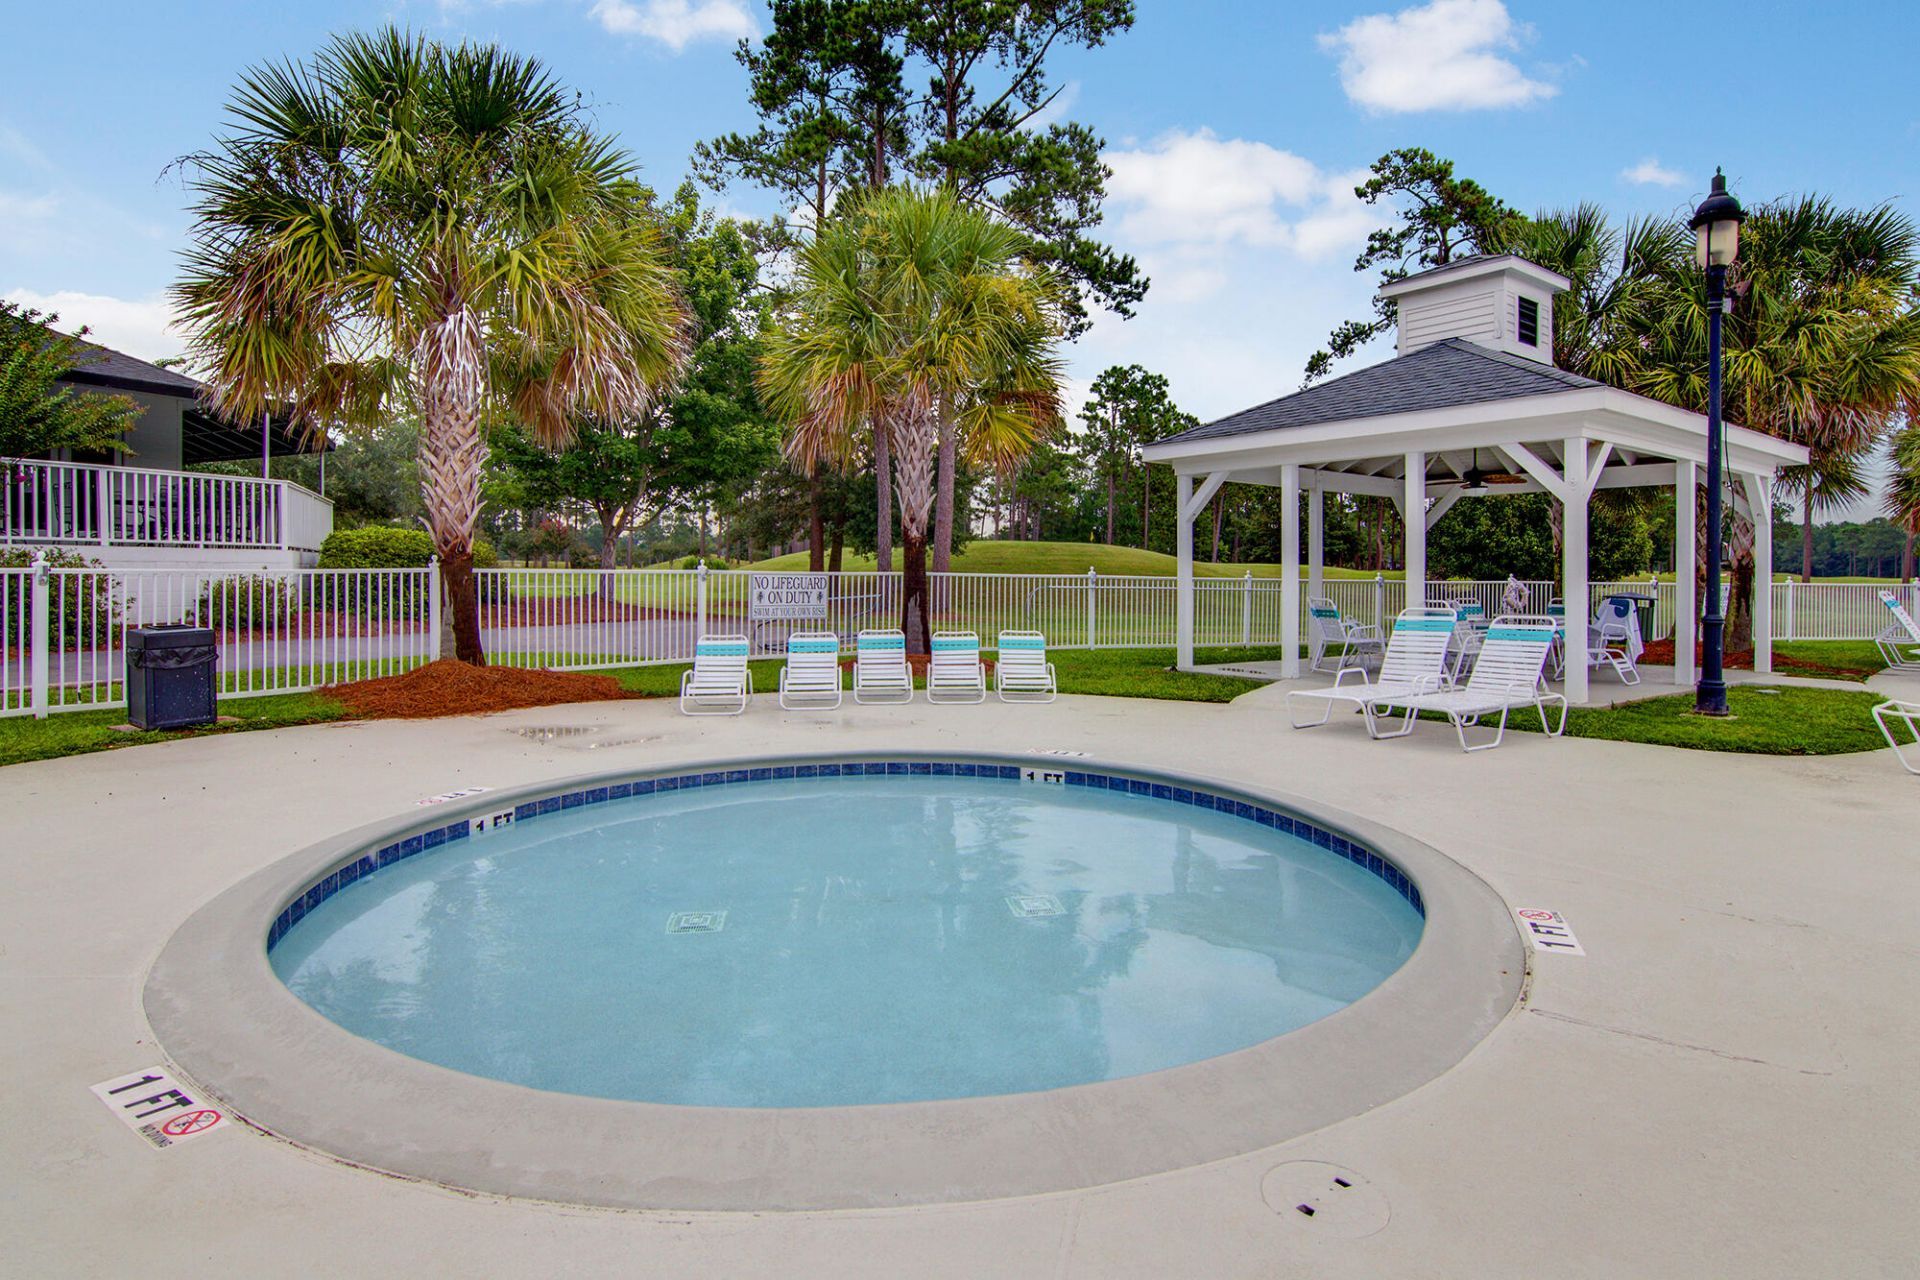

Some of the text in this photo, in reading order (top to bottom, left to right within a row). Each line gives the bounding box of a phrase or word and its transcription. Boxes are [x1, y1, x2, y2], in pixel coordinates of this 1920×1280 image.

[754, 576, 828, 590] NO LIFEGUARD
[767, 590, 812, 604] ON DUTY
[754, 607, 825, 616] SWIM AT YOUR OWN RISK
[1027, 771, 1034, 781] 1
[476, 819, 484, 832] 1
[1529, 921, 1576, 948] 1 FT
[108, 1075, 194, 1119] 1 FT
